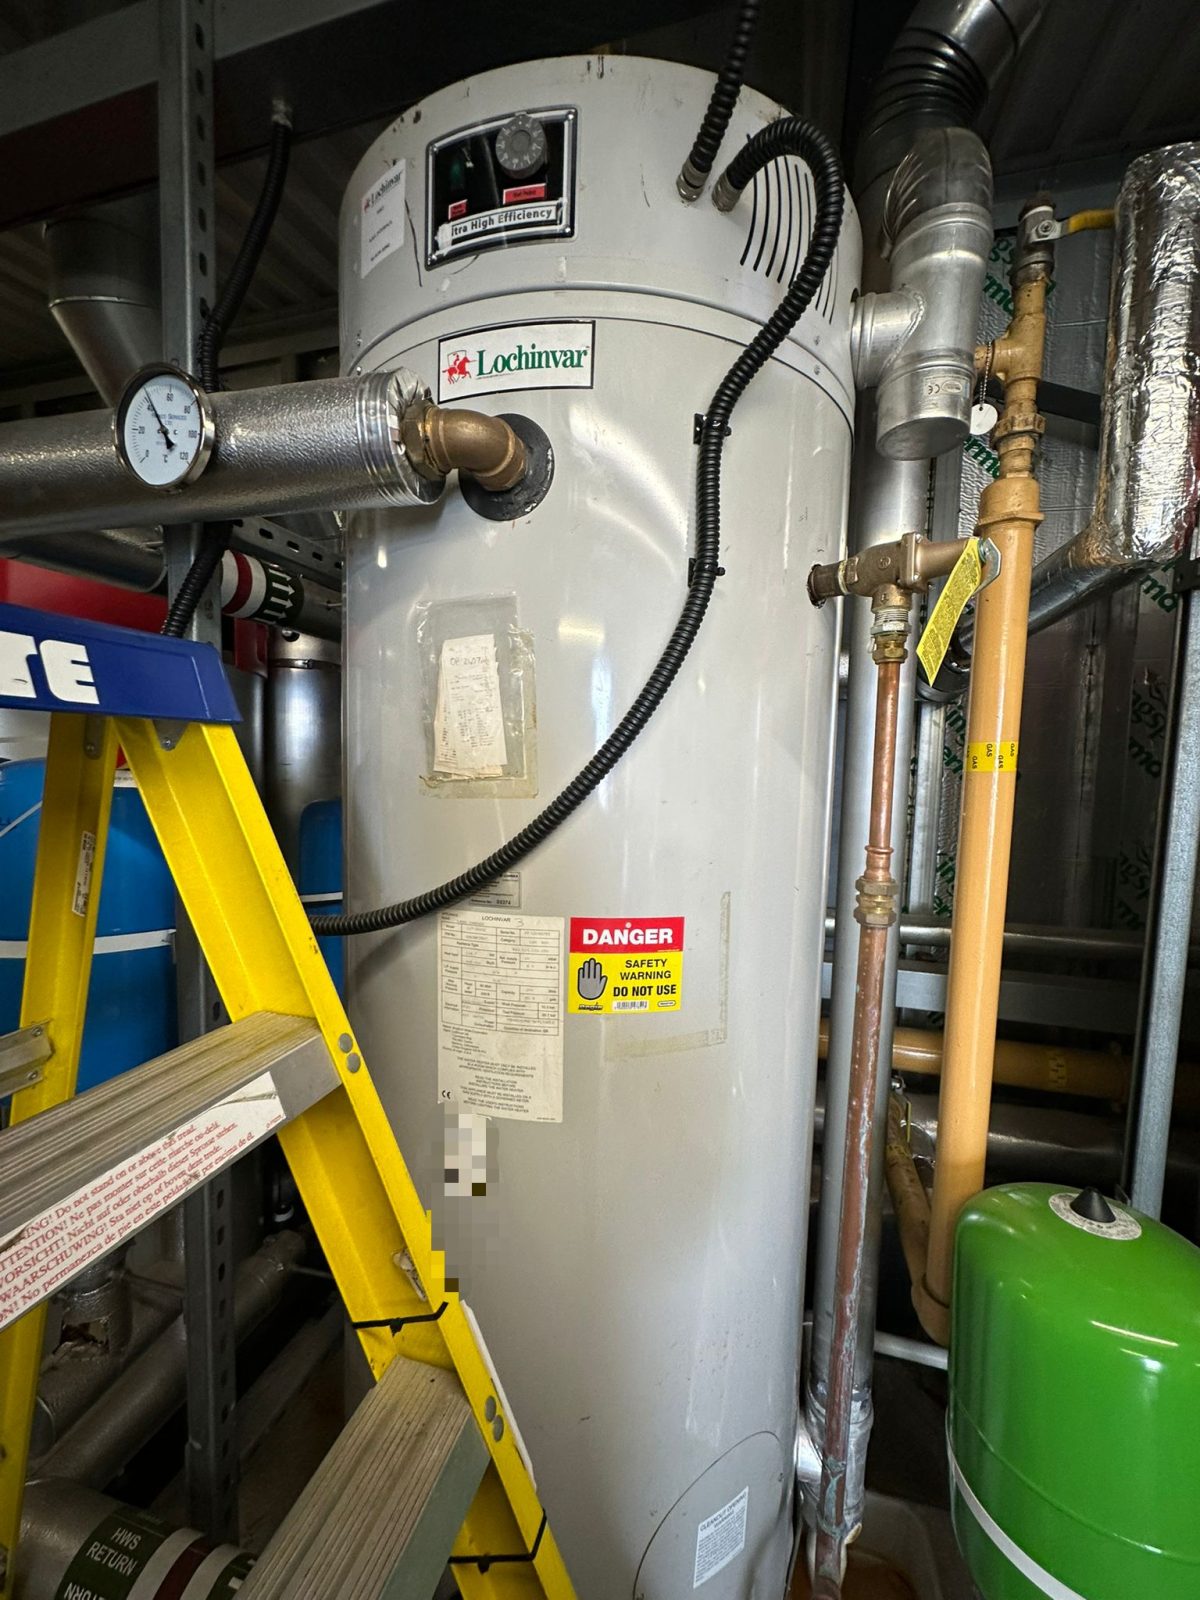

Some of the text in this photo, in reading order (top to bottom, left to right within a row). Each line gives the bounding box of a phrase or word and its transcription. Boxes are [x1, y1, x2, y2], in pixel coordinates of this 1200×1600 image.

[471, 217, 494, 230] High
[499, 209, 552, 224] Efficiency
[476, 343, 588, 376] Lochinvar
[583, 928, 673, 945] DANGER
[620, 970, 671, 980] WARNING
[626, 959, 668, 968] SAFETY
[613, 984, 677, 996] DO NOT USE
[55, 1206, 71, 1219] Do
[73, 1194, 89, 1208] not
[91, 1176, 114, 1196] stand
[116, 1170, 126, 1180] on
[128, 1163, 137, 1172] or
[138, 1148, 161, 1165] above
[67, 1219, 94, 1240] Nicht
[96, 1205, 111, 1220] auf
[113, 1194, 131, 1210] oder
[133, 1170, 167, 1196] oberhalb
[168, 1154, 189, 1172] dieser
[189, 1137, 215, 1156] Sprosse
[70, 1212, 85, 1224] Ne
[86, 1201, 102, 1216] pas
[104, 1179, 133, 1202] monter
[135, 1169, 148, 1180] sur
[148, 1158, 167, 1172] cette
[168, 1140, 193, 1159] marche
[109, 1214, 124, 1227] Sta
[125, 1201, 141, 1216] niet
[143, 1194, 154, 1203] op
[154, 1183, 164, 1195] of
[164, 1170, 187, 1188] boven
[21, 1288, 40, 1305] No
[42, 1243, 103, 1292] permanezca
[104, 1233, 116, 1245] de
[118, 1222, 132, 1237] pie
[133, 1214, 144, 1224] en
[145, 1201, 161, 1215] este
[202, 1163, 214, 1176] por
[238, 1139, 247, 1147] de
[110, 1527, 142, 1550] HWS
[86, 1541, 138, 1576] RETURN
